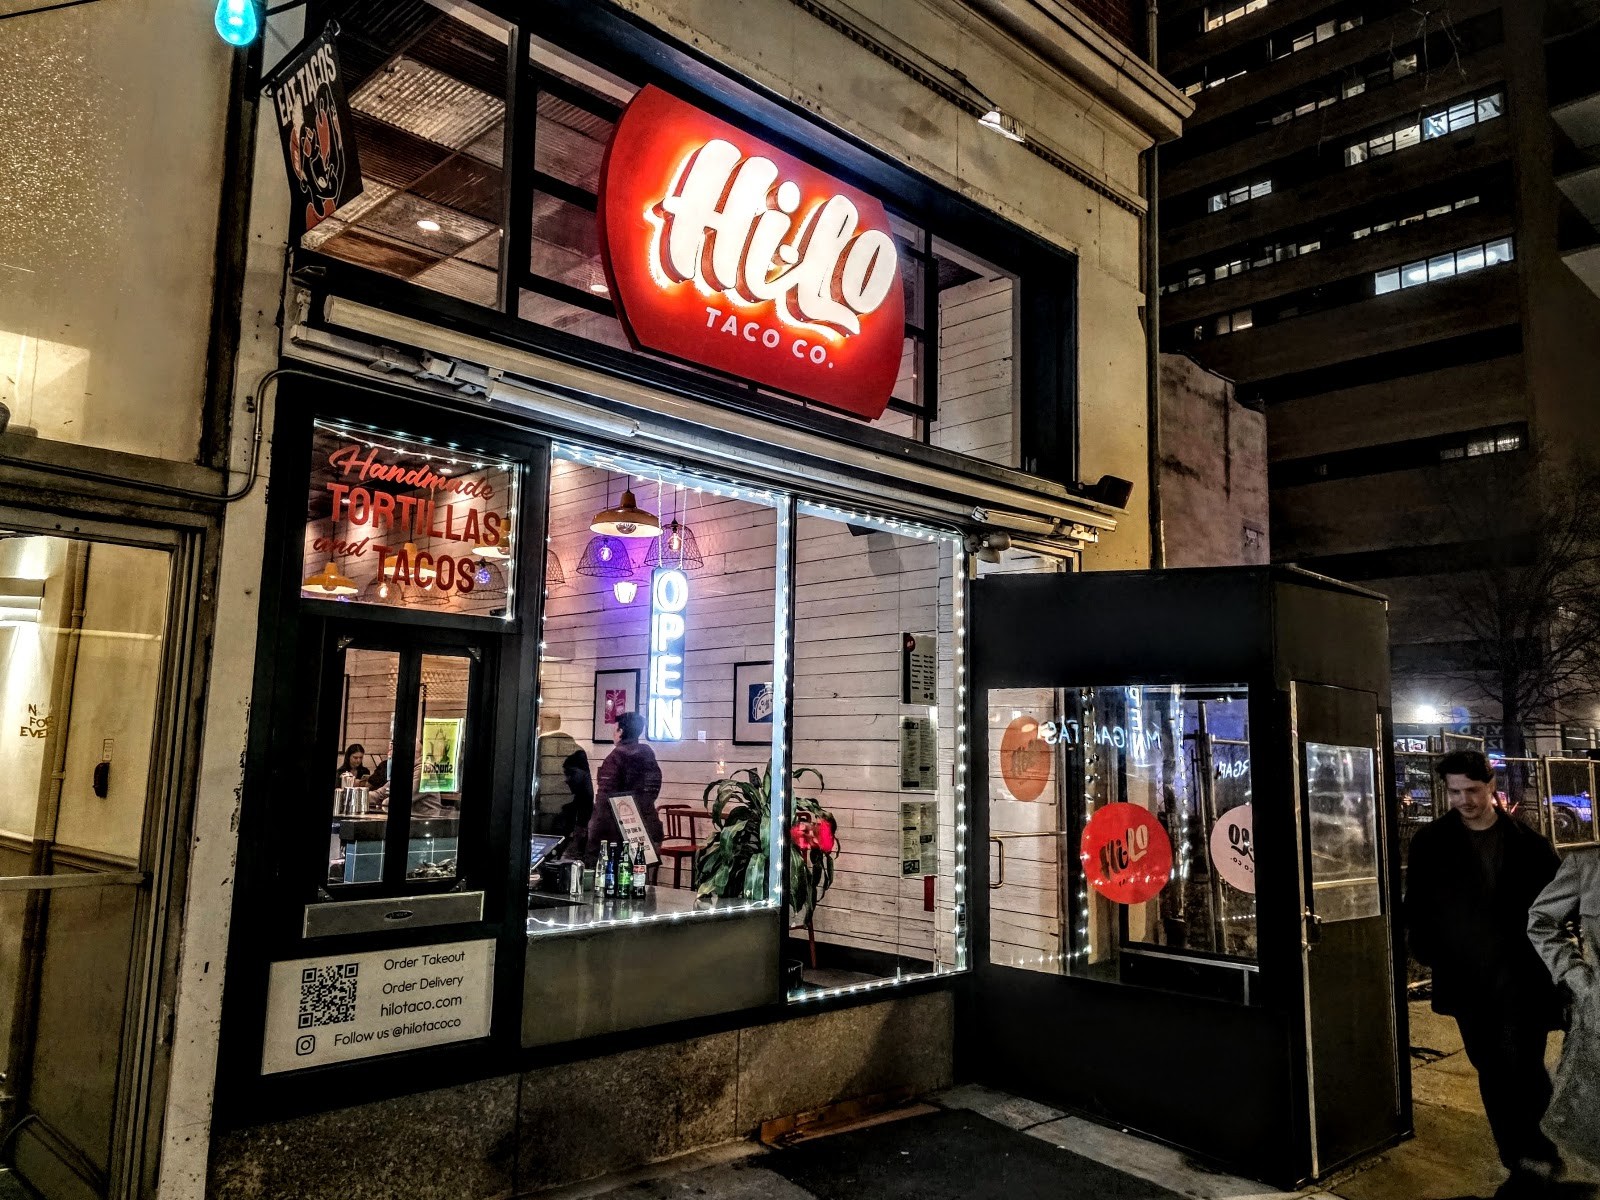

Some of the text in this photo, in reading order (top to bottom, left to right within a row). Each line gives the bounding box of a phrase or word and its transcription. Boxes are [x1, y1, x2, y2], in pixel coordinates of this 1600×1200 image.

[277, 44, 336, 126] EAT TACOS
[706, 306, 834, 369] TACO CO.
[328, 445, 496, 501] Handmade
[327, 483, 501, 546] TORTILLAS
[313, 536, 475, 593] and TACOS
[649, 570, 688, 740] OPEN
[382, 975, 465, 995] Order Delivery
[384, 951, 466, 971] Order Takeout
[334, 1017, 461, 1047] Follow us @hilotacoco
[380, 996, 462, 1017] hilotaco.com
